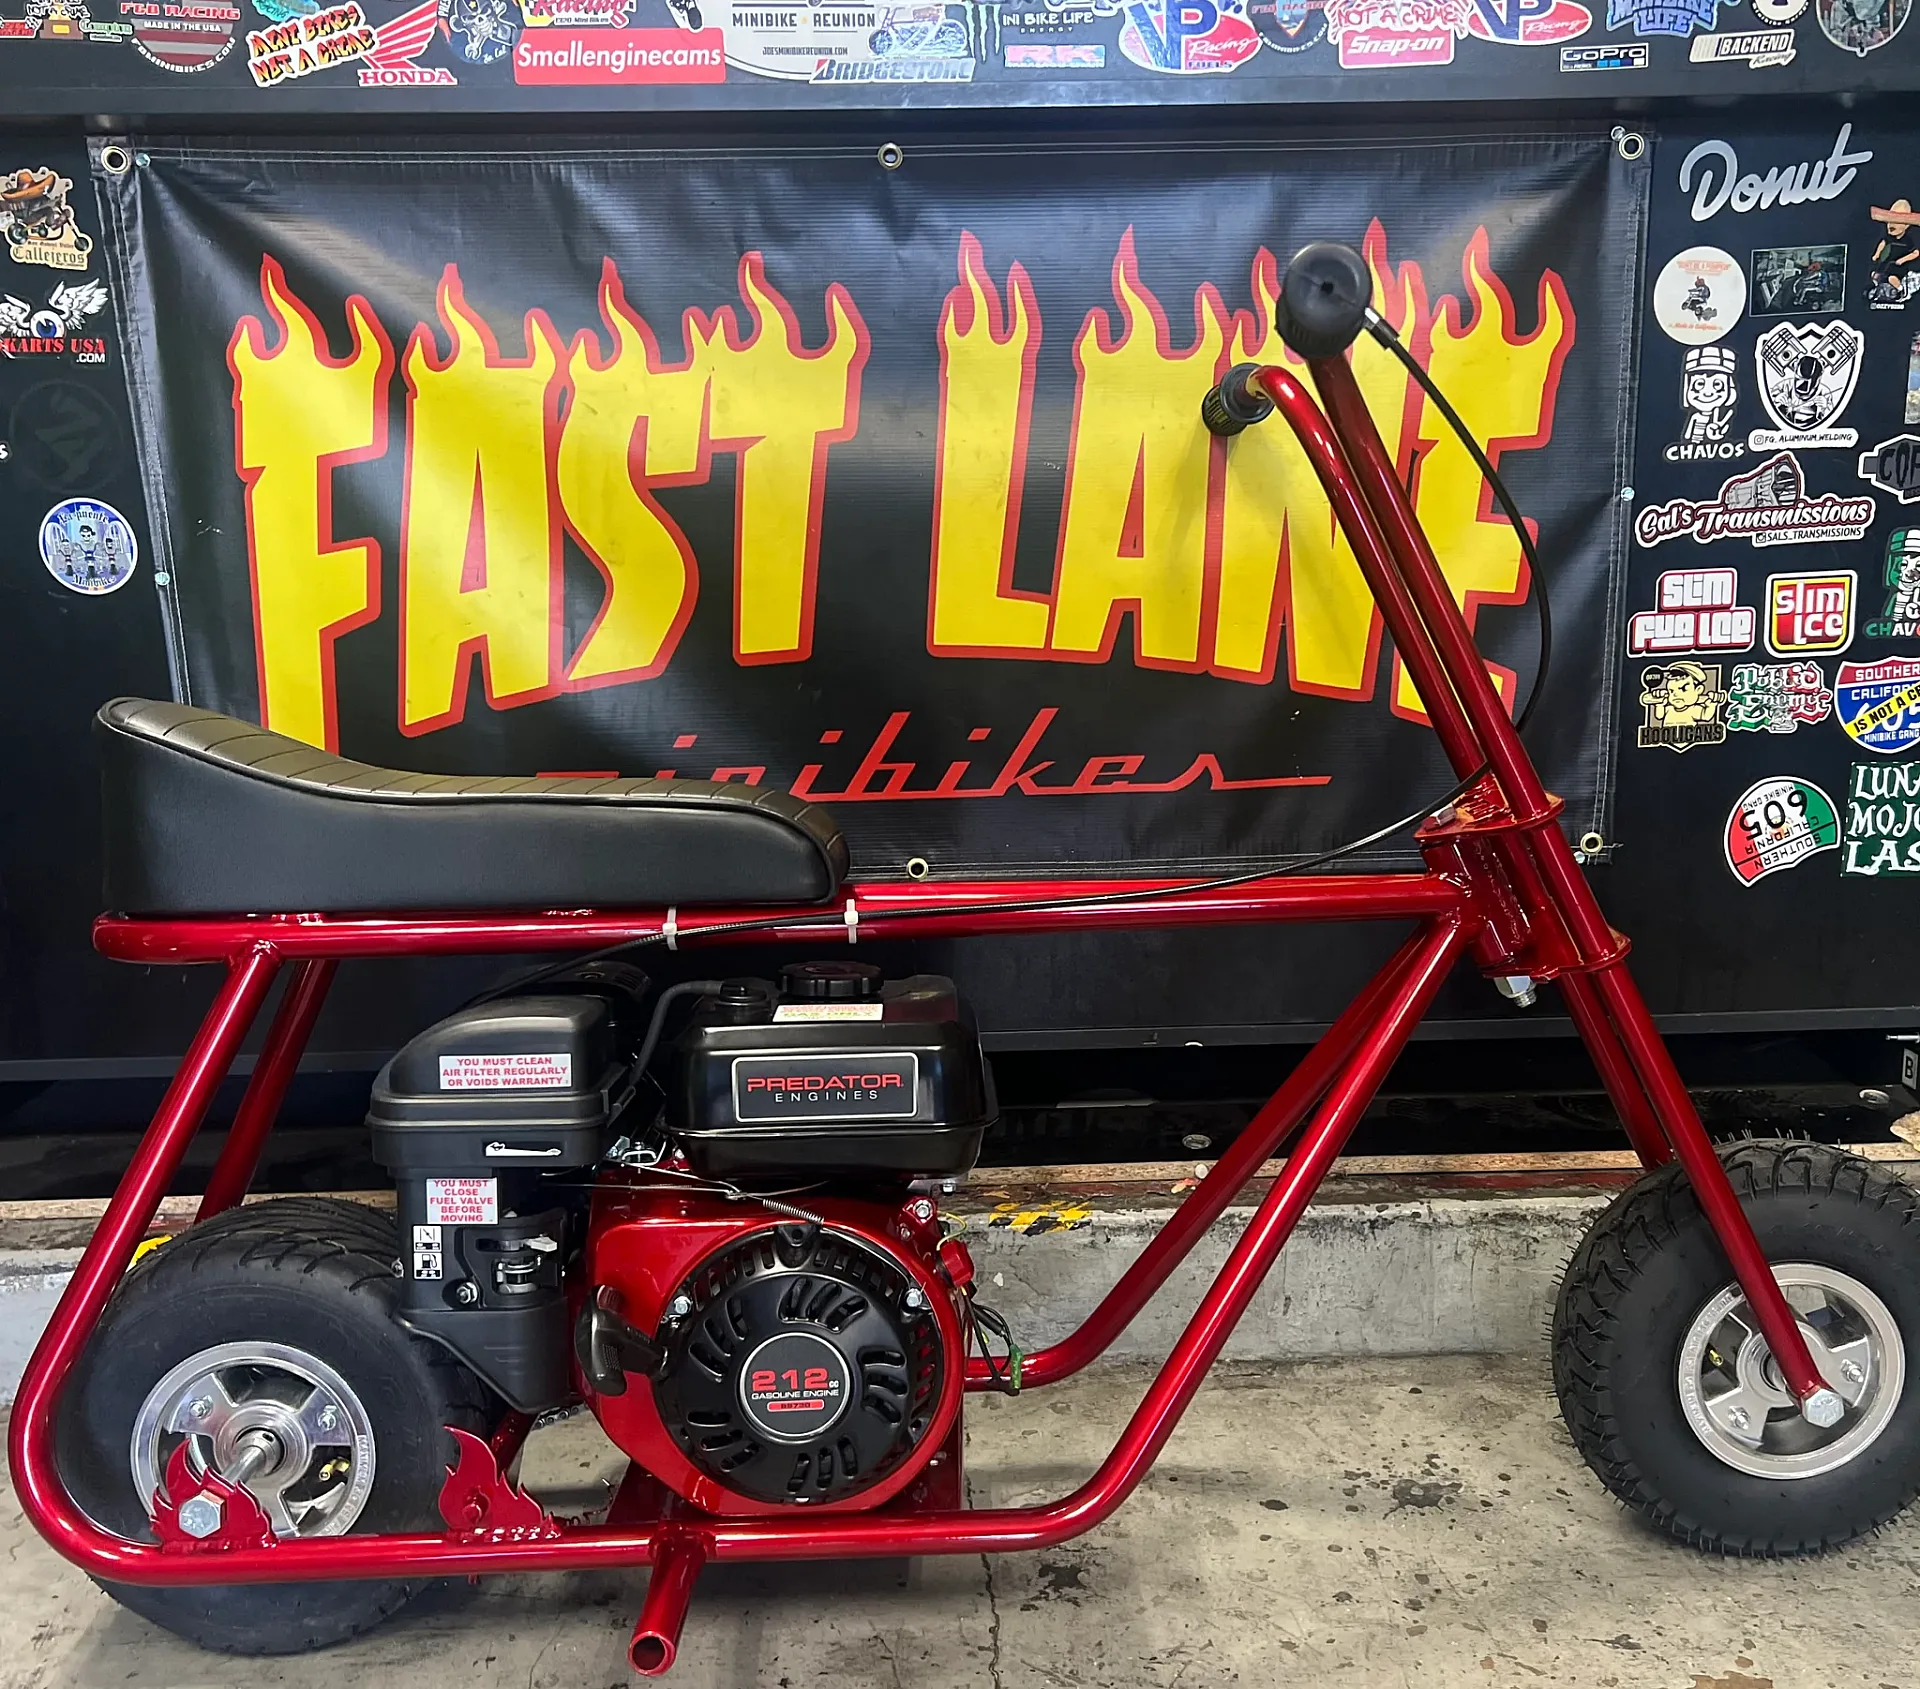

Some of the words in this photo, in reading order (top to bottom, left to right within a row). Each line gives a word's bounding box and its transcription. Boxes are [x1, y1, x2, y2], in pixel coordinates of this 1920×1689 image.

[164, 4, 241, 20] RACING
[732, 12, 797, 27] MINIBIKE
[813, 12, 876, 27] REUNION
[1024, 12, 1059, 25] BIKE
[1338, 7, 1378, 25] NOT
[1380, 9, 1398, 24] A
[144, 20, 170, 30] MADE
[172, 21, 182, 30] IN
[183, 22, 202, 31] THE
[203, 23, 222, 32] USA
[1638, 8, 1691, 33] LIFE
[250, 23, 302, 57] MINI
[303, 5, 361, 41] BIKES
[1187, 38, 1260, 60] Racing
[1346, 35, 1445, 56] Snap-on
[1720, 34, 1791, 55] BACKEND
[252, 54, 295, 82] NOT
[299, 48, 316, 71] A
[317, 29, 376, 64] CRIME
[517, 40, 721, 73] Smallenginecams
[1562, 48, 1646, 61] GoPro
[360, 70, 456, 85] HONDA
[1679, 122, 1874, 222] Donut
[13, 246, 85, 264] Callejeros
[71, 338, 106, 353] USA
[76, 353, 106, 363] .COM
[1665, 442, 1745, 461] CHAVOS
[227, 250, 871, 755] FAST
[926, 216, 1575, 727] LANE
[1642, 502, 1692, 539] Sal's
[1697, 499, 1869, 537] Transmissions
[1766, 527, 1862, 542] SALS_TRANSMISSIONS
[1853, 718, 1869, 734] IS
[1868, 702, 1893, 724] NOT
[1896, 696, 1907, 709] A
[1640, 725, 1724, 745] HOOLIGANS
[1864, 730, 1897, 743] MINIBIKE
[1898, 728, 1920, 740] GANG
[1764, 783, 1794, 802] MINIBIKE
[1743, 799, 1763, 812] GANG
[1744, 816, 1820, 855] CALIFORNIA
[1754, 834, 1822, 870] SOUTHERN
[456, 1058, 479, 1066] YOU
[482, 1057, 513, 1066] MUST
[516, 1056, 552, 1065] CLEAN
[442, 1068, 461, 1077] AIR
[464, 1068, 500, 1077] FILTER
[504, 1066, 568, 1076] REGULARLY
[448, 1078, 463, 1087] OR
[467, 1078, 499, 1087] VOIDS
[502, 1077, 563, 1086] WARRANTY
[747, 1073, 902, 1092] PREDATOR
[775, 1089, 879, 1103] ENGINES
[434, 1179, 455, 1187] YOU
[459, 1179, 488, 1187] MUST
[444, 1188, 478, 1196] CLOSE
[430, 1197, 456, 1205] FUEL
[459, 1196, 493, 1205] VALVE
[441, 1206, 483, 1214] BEFORE
[441, 1214, 483, 1222] MOVING
[752, 1391, 800, 1399] GASOLINE
[803, 1389, 839, 1398] ENGINE
